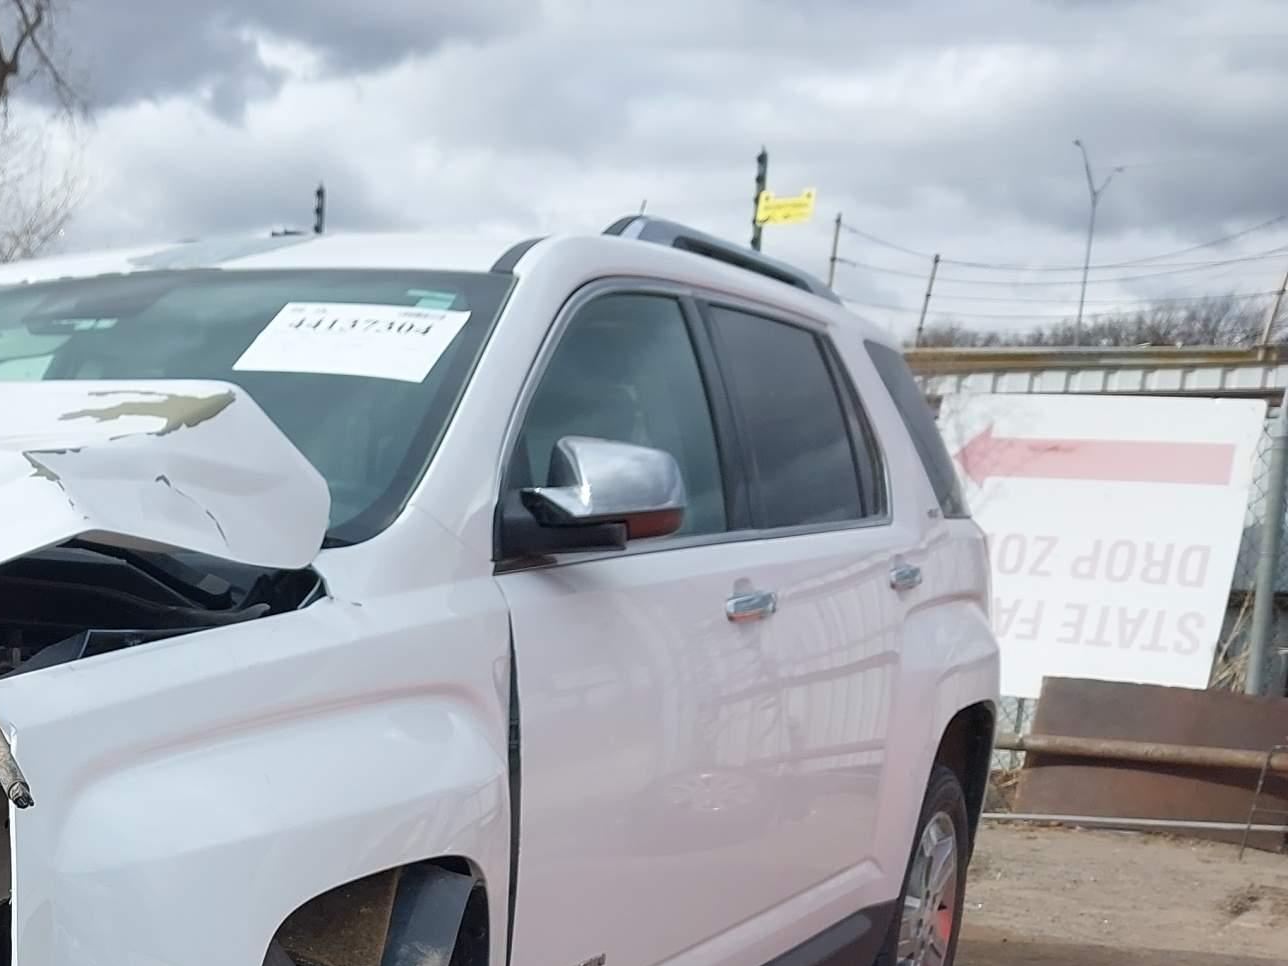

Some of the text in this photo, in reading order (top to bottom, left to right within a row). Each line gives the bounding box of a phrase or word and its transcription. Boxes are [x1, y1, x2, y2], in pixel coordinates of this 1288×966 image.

[289, 317, 434, 336] 44137304
[989, 533, 1211, 588] DROP ZO
[993, 597, 1207, 655] STATE FA
